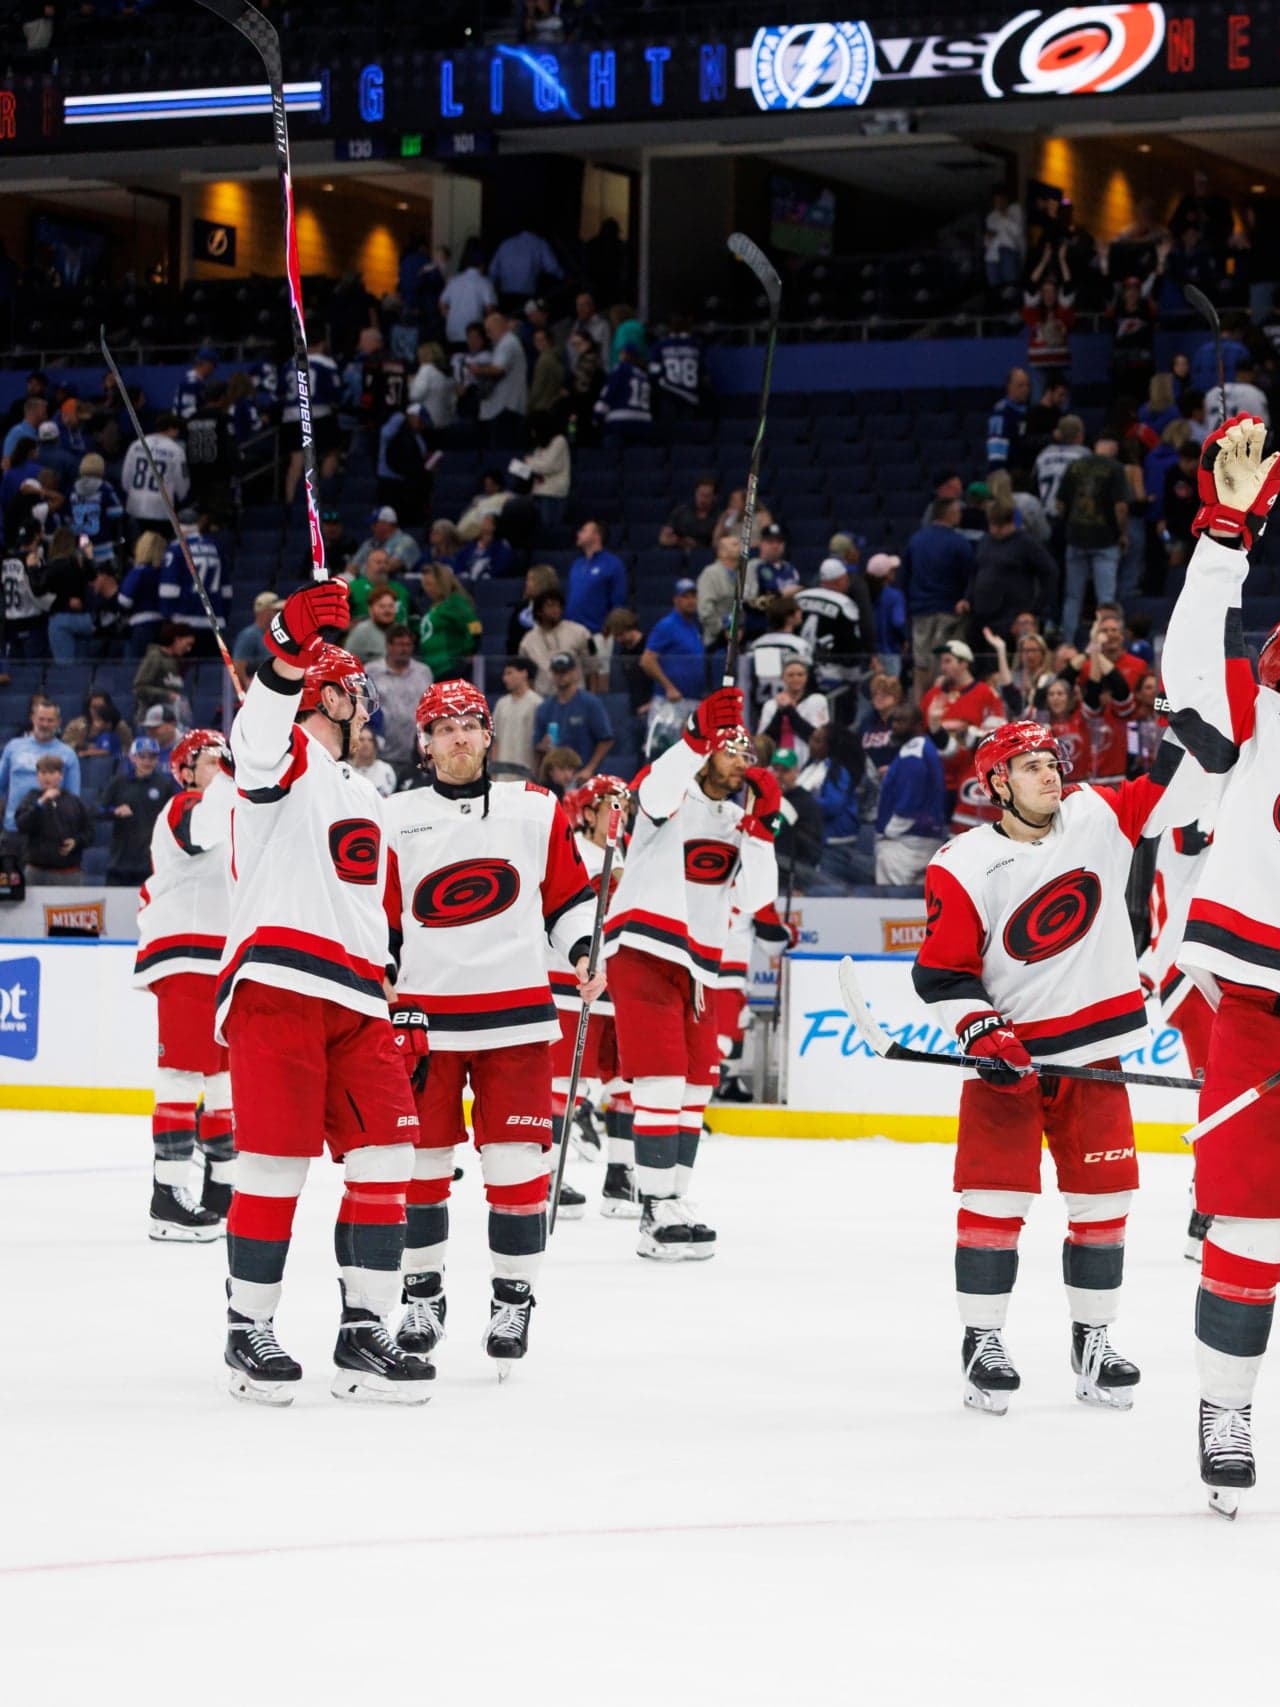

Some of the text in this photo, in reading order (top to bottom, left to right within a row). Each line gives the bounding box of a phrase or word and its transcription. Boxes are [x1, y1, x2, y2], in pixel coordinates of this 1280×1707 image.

[876, 35, 985, 78] VS
[273, 94, 286, 153] FLYLITE
[348, 141, 373, 160] 130
[296, 370, 311, 435] BAUER
[1083, 1147, 1135, 1164] CCM
